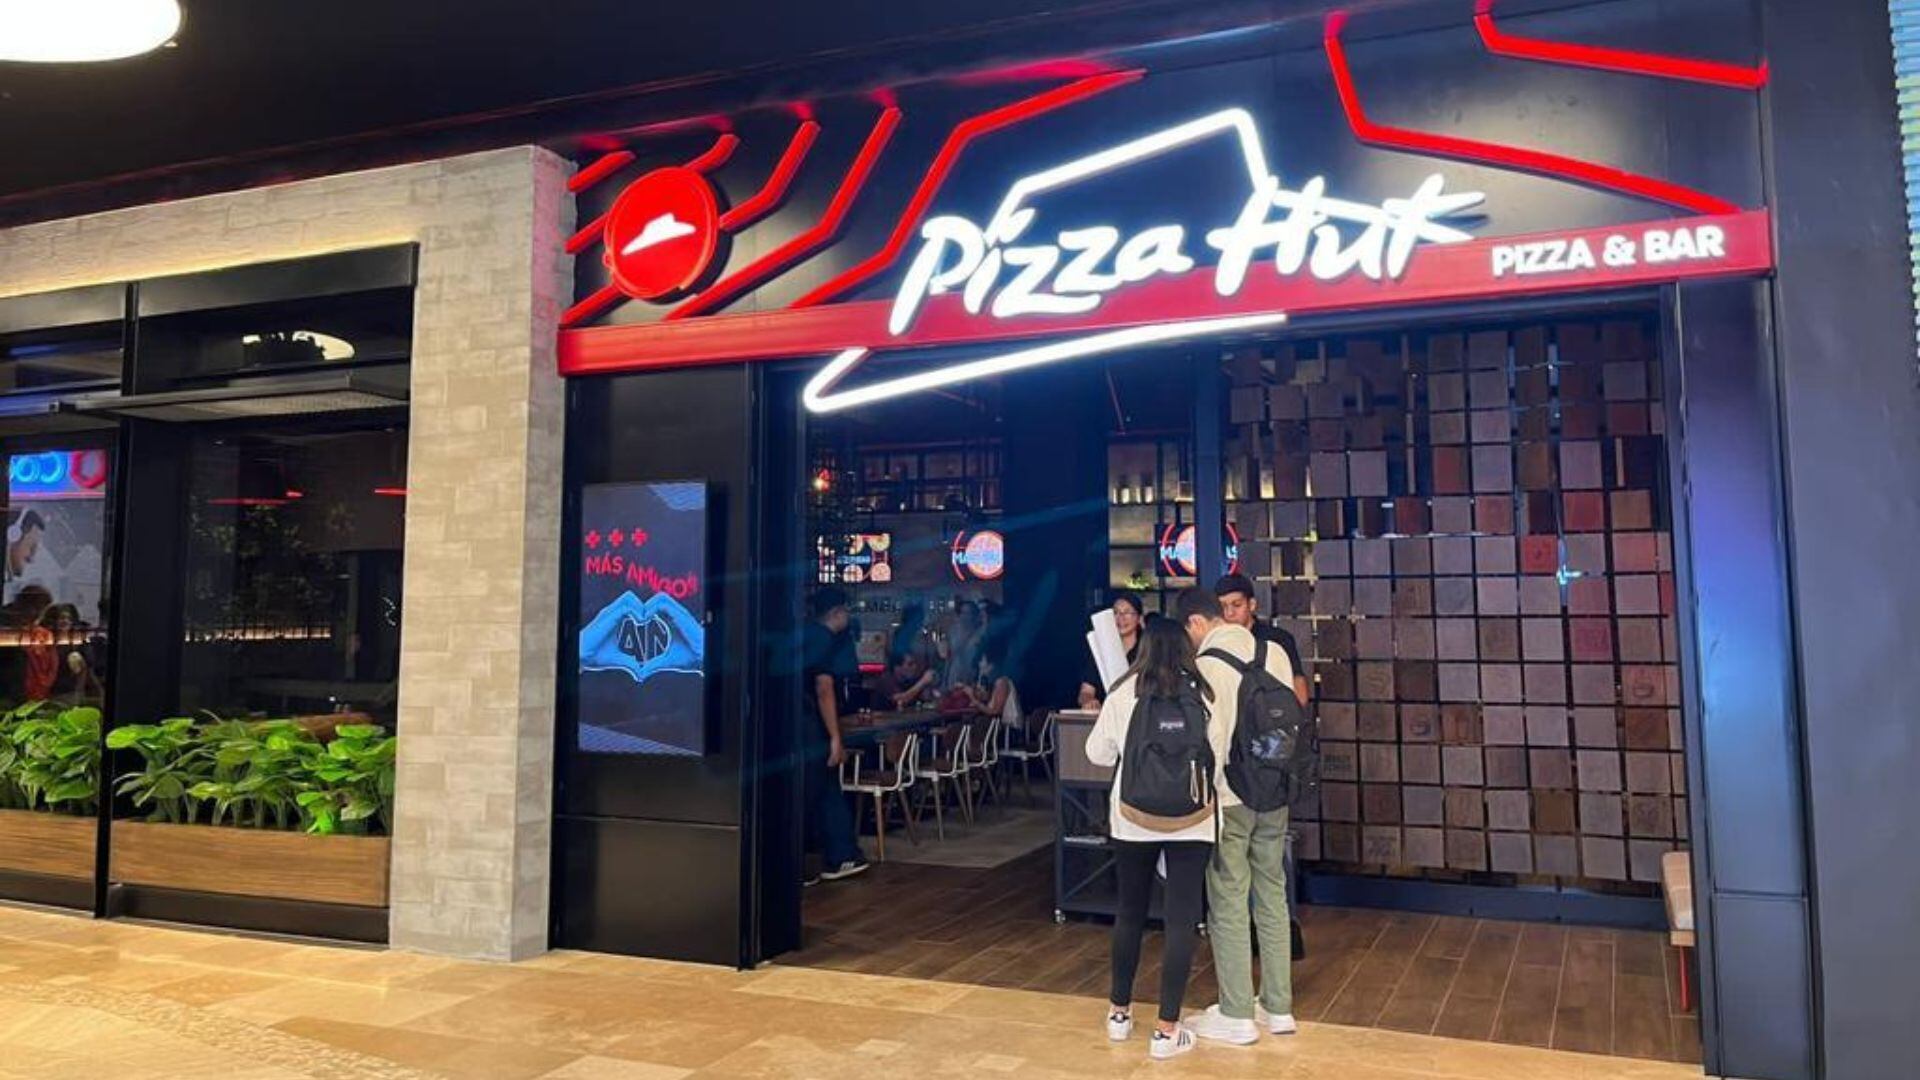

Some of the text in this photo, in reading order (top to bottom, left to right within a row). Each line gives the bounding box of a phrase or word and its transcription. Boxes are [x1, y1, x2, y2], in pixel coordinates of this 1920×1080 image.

[889, 173, 1486, 335] Pizza Hut
[1491, 224, 1726, 277] PIZZA & BAR
